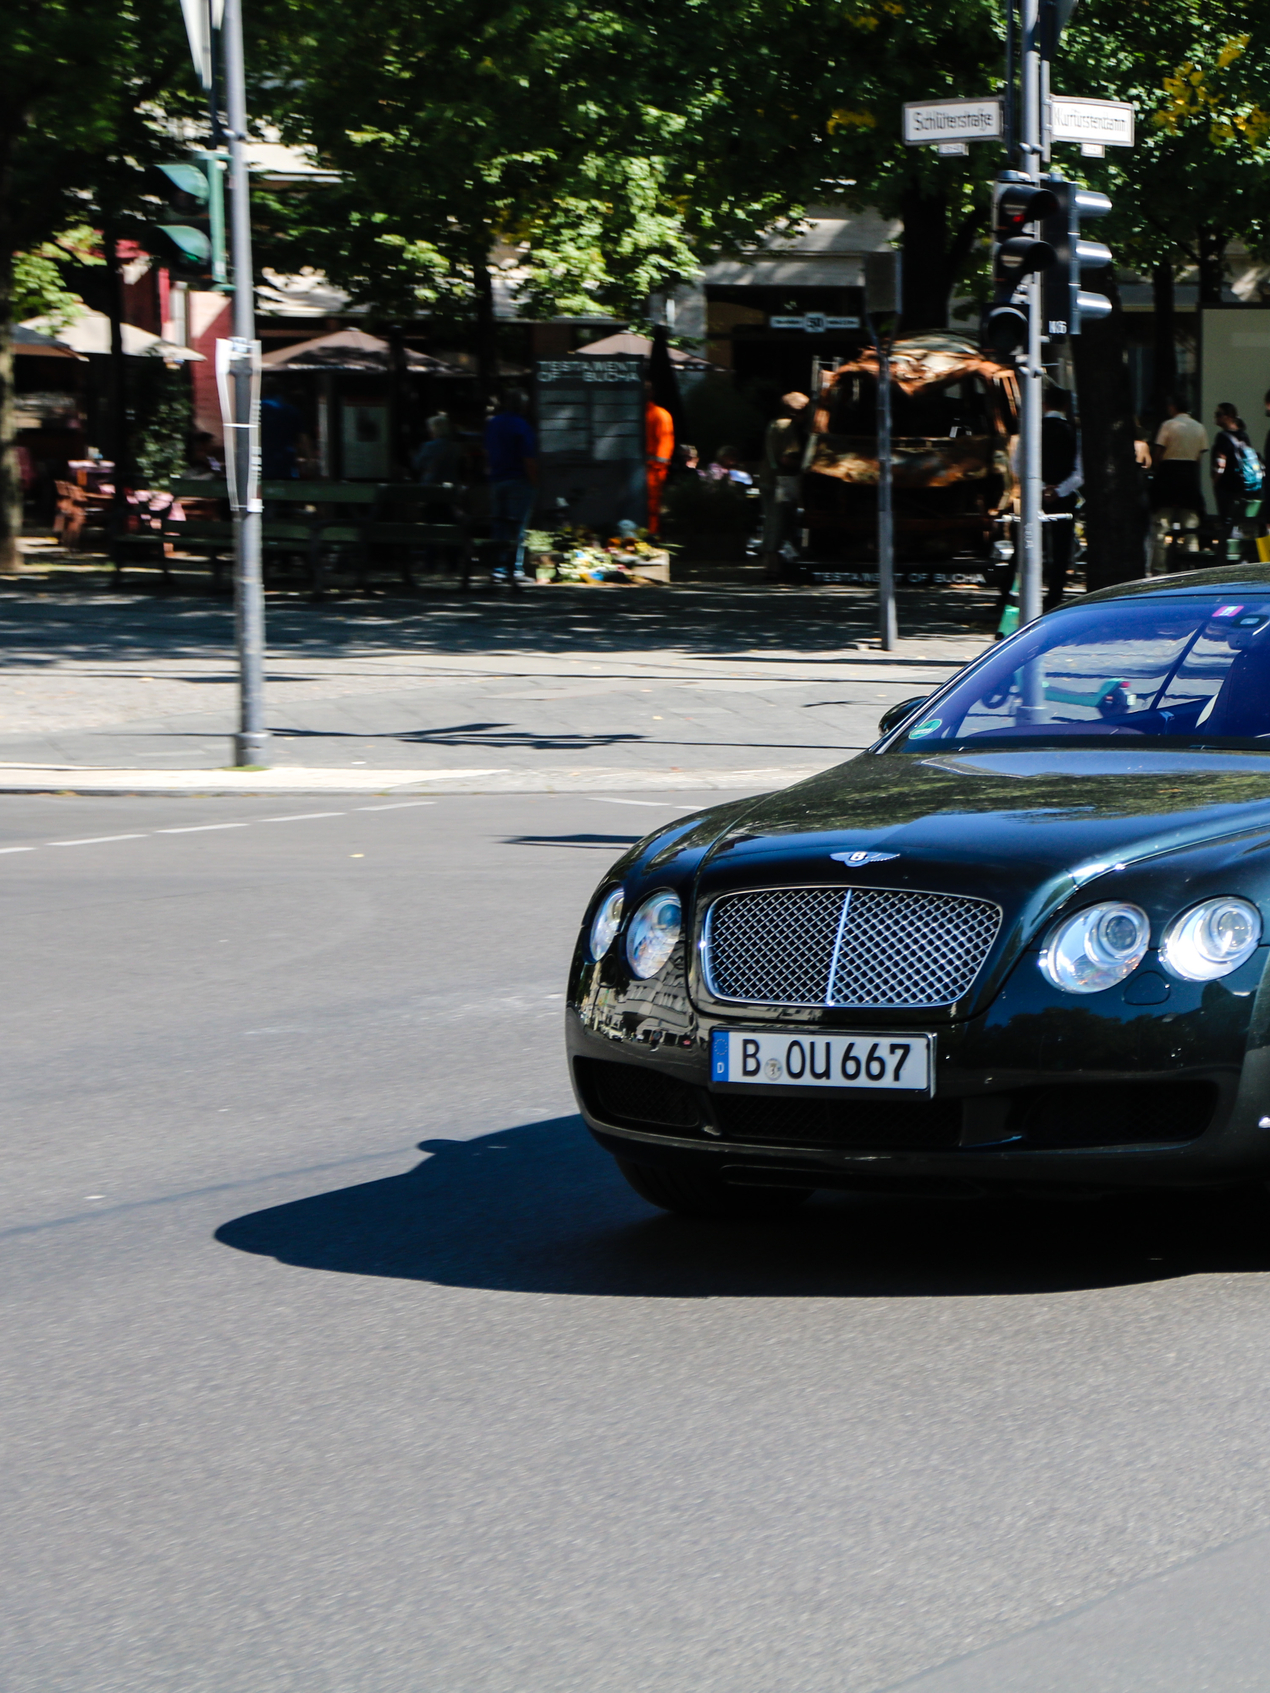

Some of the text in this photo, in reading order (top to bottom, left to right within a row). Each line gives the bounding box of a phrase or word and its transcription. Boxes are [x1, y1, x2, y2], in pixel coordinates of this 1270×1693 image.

[912, 108, 993, 132] Schlüterstraße
[1053, 107, 1127, 132] Kurfürstendamm
[537, 361, 640, 371] TESTAMENT
[537, 371, 641, 382] OF BUCHA
[812, 572, 986, 583] TESTAMET OF BUCHA
[742, 1039, 910, 1082] B OU 667
[717, 1063, 724, 1074] D
